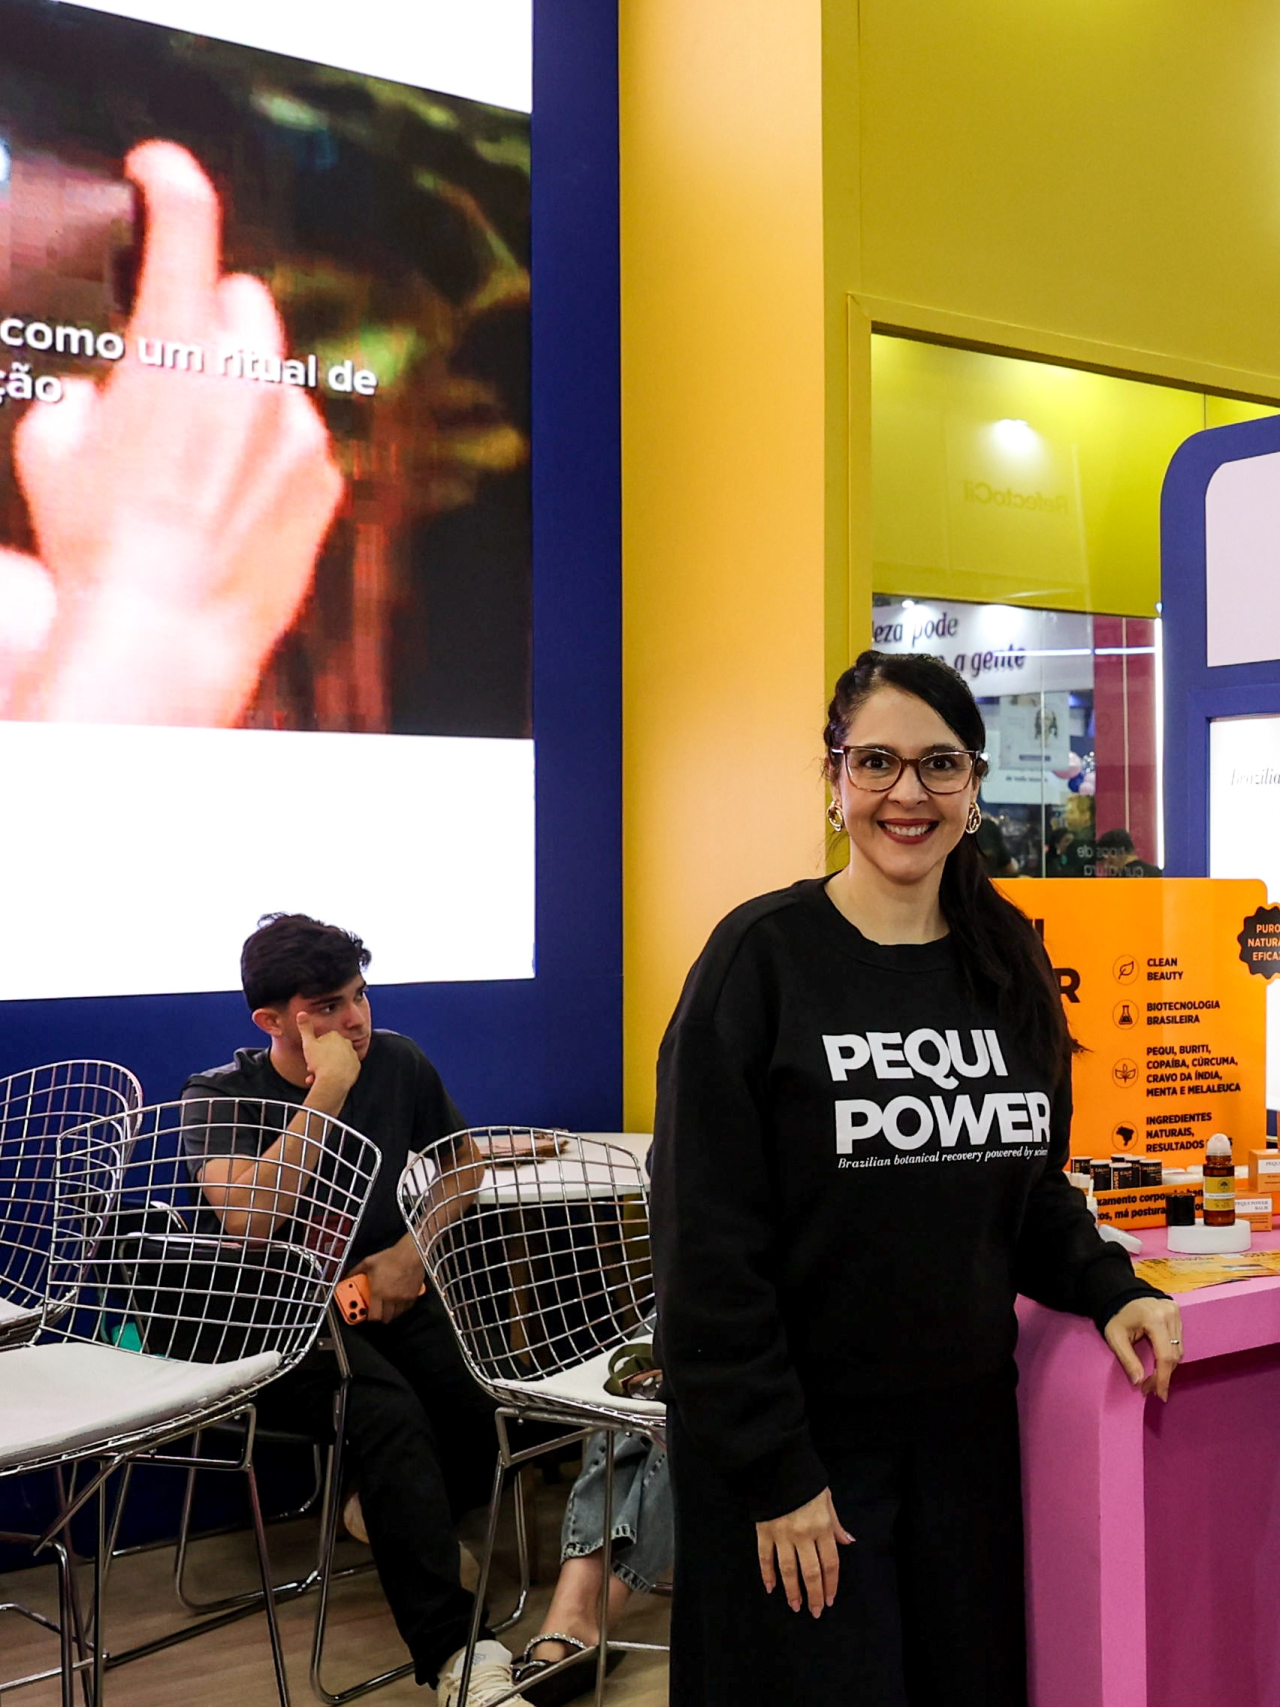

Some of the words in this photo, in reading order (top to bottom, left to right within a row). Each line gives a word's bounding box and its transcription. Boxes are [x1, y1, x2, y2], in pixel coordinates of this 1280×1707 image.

[0, 317, 125, 360] como
[138, 336, 202, 371] um
[218, 350, 318, 388] ritual
[328, 360, 378, 395] de
[913, 612, 958, 647] pode
[971, 644, 1026, 677] gente
[1256, 924, 1280, 933] PURO
[1147, 958, 1178, 967] CLEAN
[1147, 971, 1183, 981] BEAUTY
[1147, 1000, 1220, 1012] BIOTECNOLOGIA
[1147, 1014, 1200, 1025] BRASILEIRA
[1147, 1046, 1177, 1057] PEQUI,
[1179, 1044, 1211, 1054] BURITI,
[822, 1028, 1008, 1090] PEQUI
[1147, 1057, 1190, 1070] COPAÍBA,
[1191, 1055, 1238, 1067] CÚRCUMA,
[1147, 1073, 1177, 1083] CRAVO
[1180, 1072, 1192, 1081] DA
[1195, 1069, 1222, 1080] ÍNDIA,
[1147, 1087, 1177, 1098] MENTA
[1180, 1086, 1185, 1095] E
[1187, 1083, 1241, 1095] MELALEUCA
[834, 1092, 1050, 1154] POWER
[1146, 1112, 1212, 1125] INGREDIENTES
[1146, 1127, 1194, 1139] NATURAIS,
[1146, 1140, 1204, 1153] RESULTADOS
[838, 1157, 891, 1169] Brazilian
[894, 1152, 939, 1165] botanical
[941, 1151, 983, 1163] recovery
[984, 1146, 1023, 1162] powered
[1024, 1145, 1034, 1160] by
[1139, 1192, 1166, 1203] corpo
[1114, 1208, 1129, 1219] má
